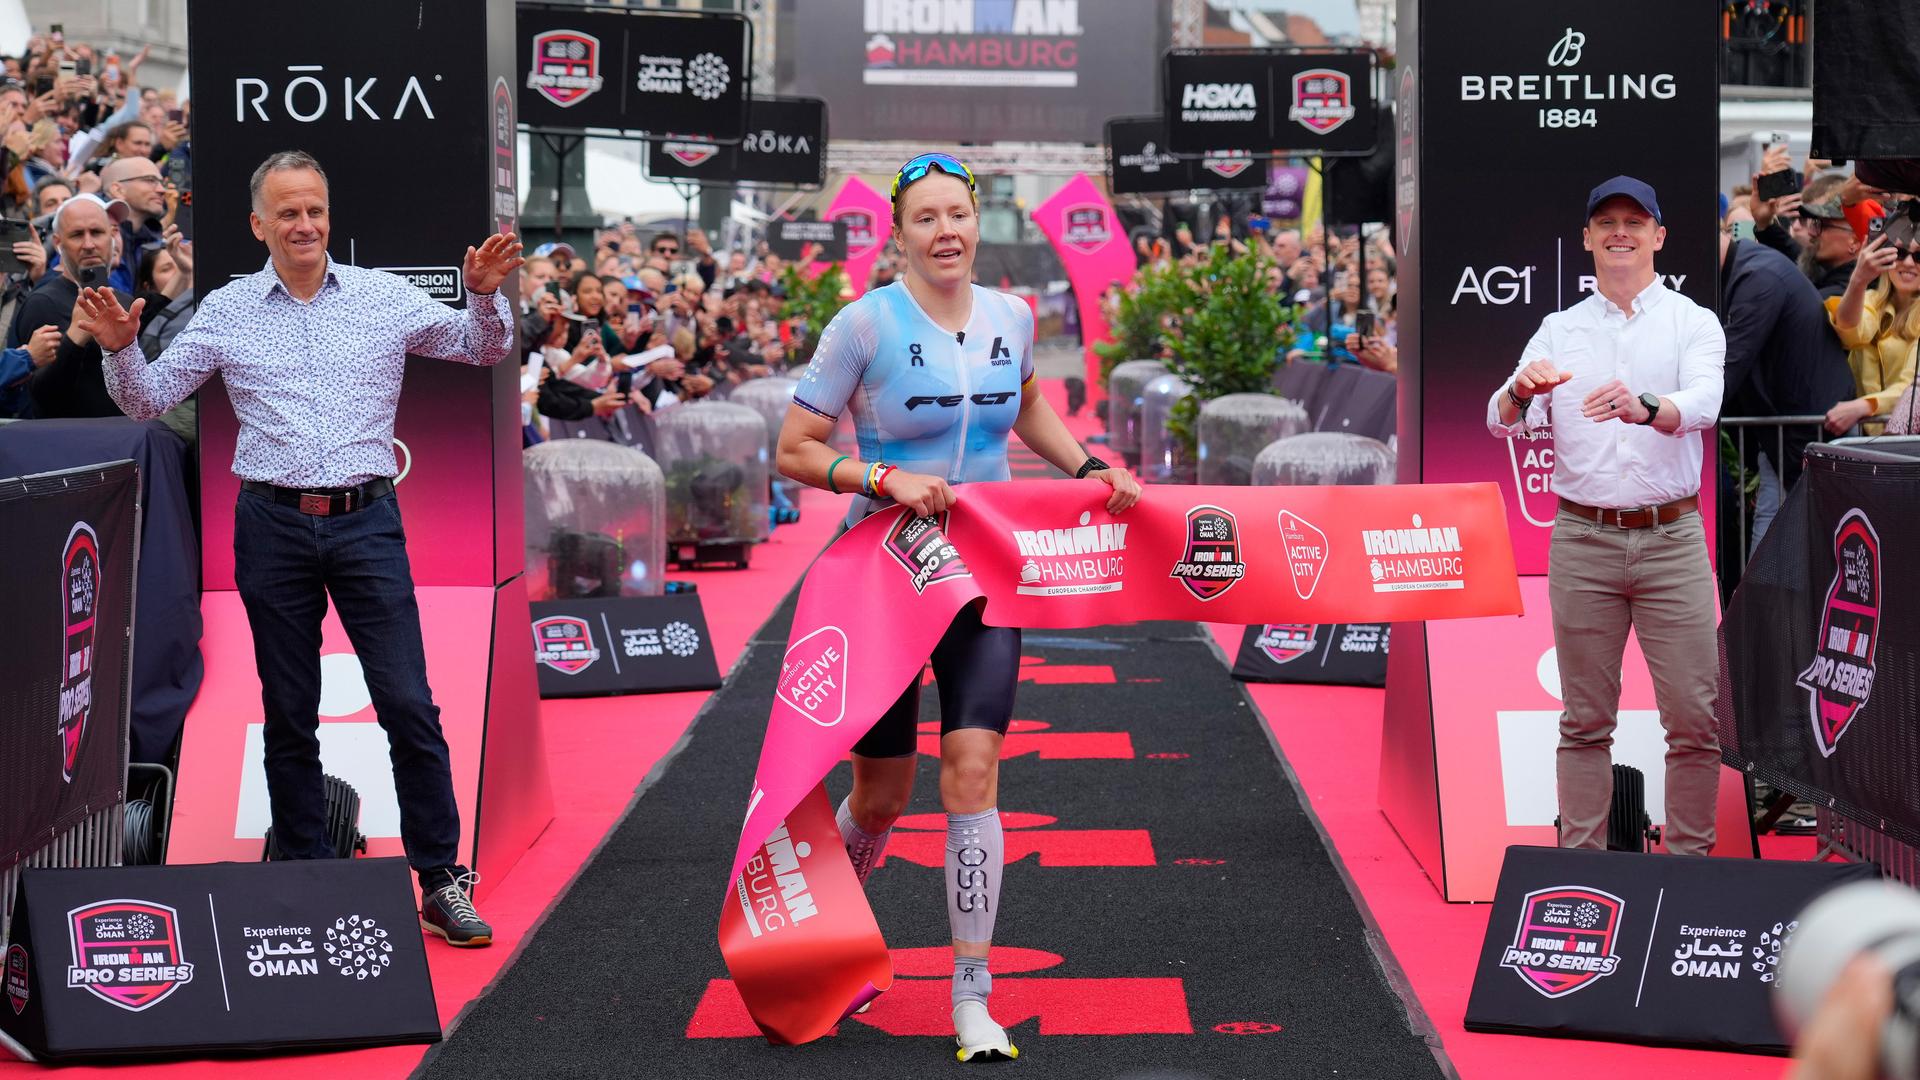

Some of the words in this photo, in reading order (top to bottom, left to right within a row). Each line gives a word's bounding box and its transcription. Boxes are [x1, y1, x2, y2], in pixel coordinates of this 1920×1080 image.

[864, 0, 1078, 35] IRONMAN
[898, 37, 1079, 67] HAMBURG
[1182, 83, 1257, 108] HOKA
[1461, 74, 1677, 101] BREITLING
[1539, 109, 1598, 128] 1884
[406, 274, 453, 286] CISION
[1450, 265, 1533, 305] AG1
[907, 523, 928, 543] OMAN
[1012, 523, 1128, 556] IRONMAN
[1362, 527, 1460, 555] IRONMAN
[916, 537, 944, 563] IRON
[1291, 545, 1321, 560] ACTIVE
[914, 556, 940, 590] PRO
[1040, 556, 1124, 581] HAMBURG
[1174, 564, 1203, 577] PRO
[1203, 564, 1244, 578] SERIES
[1294, 562, 1313, 577] CITY
[1383, 557, 1463, 578] HAMBURG
[1047, 586, 1077, 595] EUROPEAN
[625, 645, 663, 657] OMAN
[791, 646, 840, 701] ACTIVE
[1805, 655, 1834, 687] PRO
[1831, 661, 1873, 700] SERIES
[804, 675, 837, 710] CITY
[59, 688, 75, 724] PRO
[747, 854, 785, 932] BURG
[1543, 916, 1570, 924] OMAN
[243, 925, 312, 939] Experience
[1680, 925, 1747, 938] Experience
[1531, 938, 1597, 954] IRONMAN
[93, 952, 164, 966] IRONMAN
[248, 959, 319, 977] OMAN
[1505, 949, 1545, 967] PRO
[1546, 954, 1615, 972] SERIES
[1671, 959, 1741, 979] OMAN
[72, 968, 114, 983] PRO
[118, 966, 189, 982] SERIES
